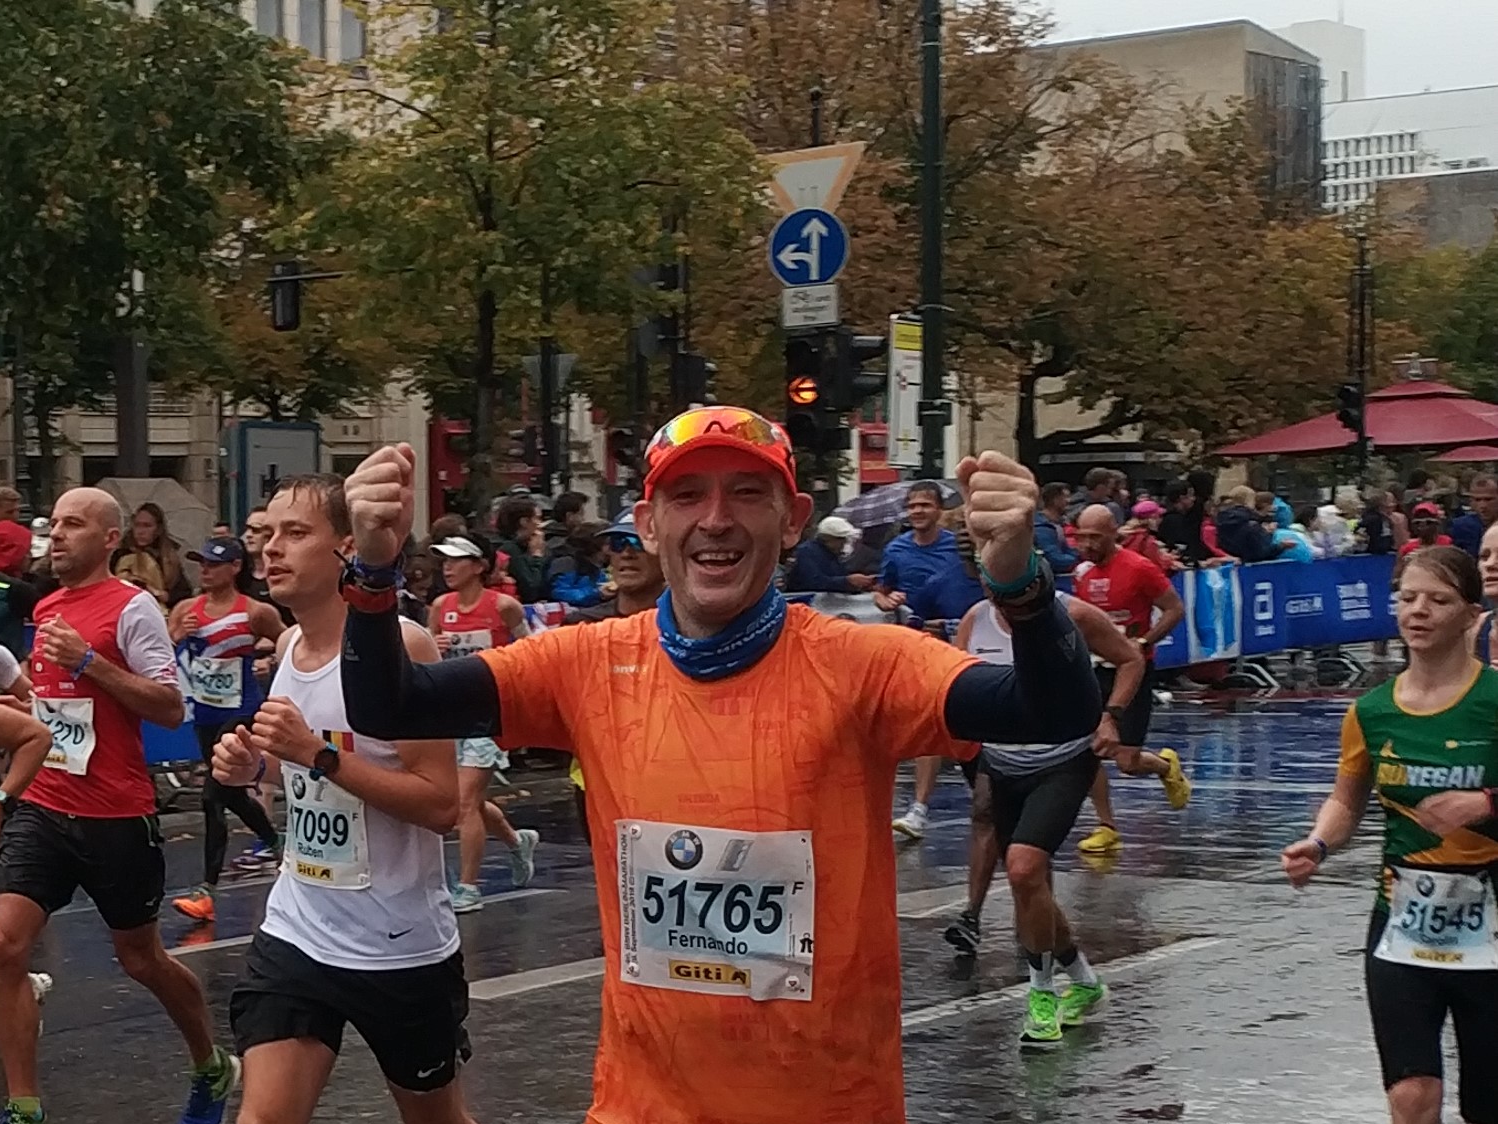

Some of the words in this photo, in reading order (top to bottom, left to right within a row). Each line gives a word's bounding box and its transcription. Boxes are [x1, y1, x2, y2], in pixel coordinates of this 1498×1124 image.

[290, 804, 349, 848] 7099
[642, 875, 785, 935] 51765
[792, 881, 805, 895] F
[1402, 900, 1484, 934] 51545
[668, 929, 749, 956] Fernando
[674, 964, 722, 981] Giti
